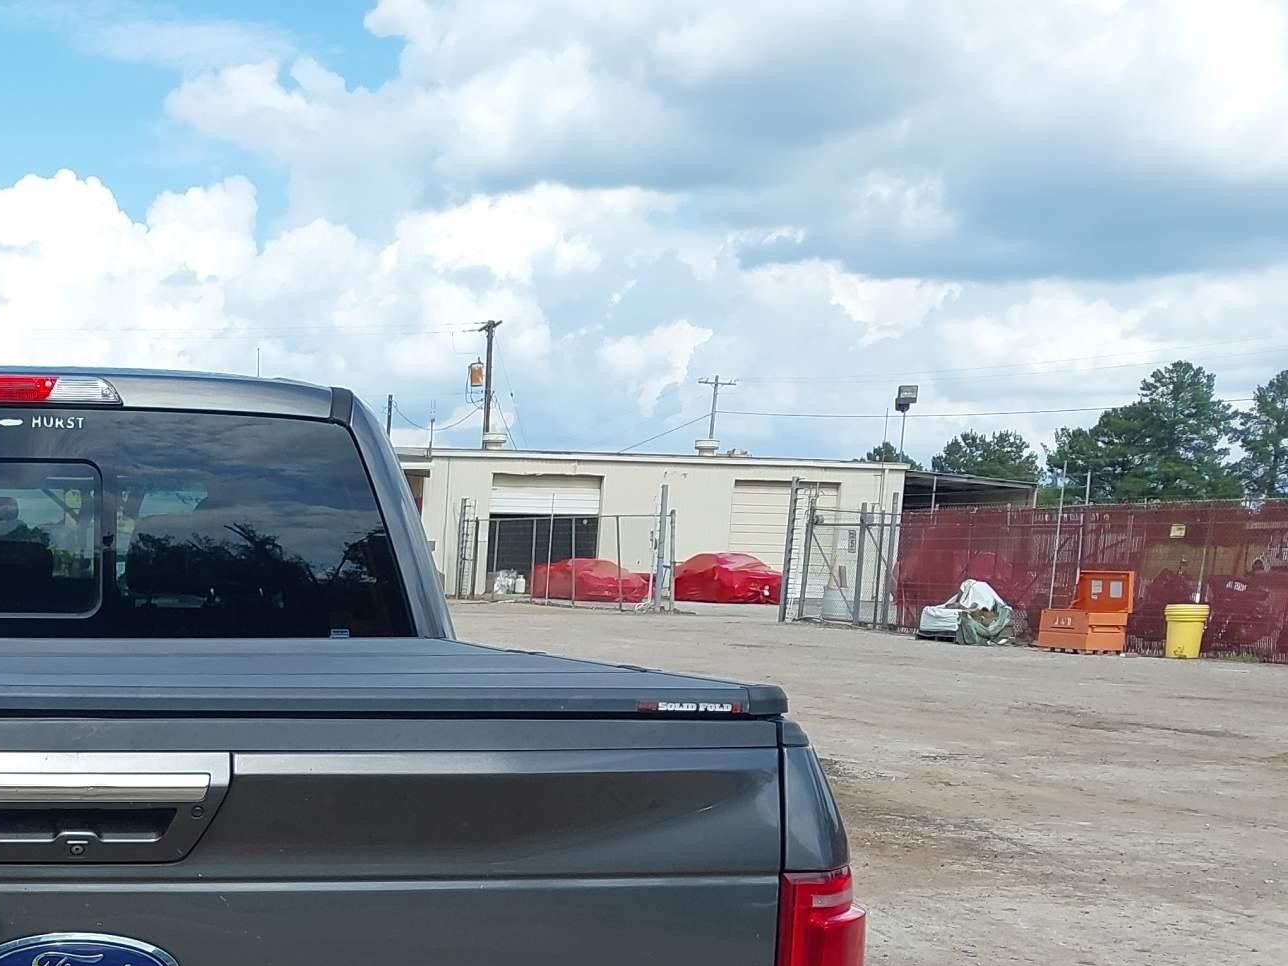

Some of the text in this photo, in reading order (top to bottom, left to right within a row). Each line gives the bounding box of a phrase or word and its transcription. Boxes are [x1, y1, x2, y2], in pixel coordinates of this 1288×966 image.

[31, 415, 85, 429] HURST
[657, 701, 697, 711] SOLID
[698, 702, 732, 712] FOLD
